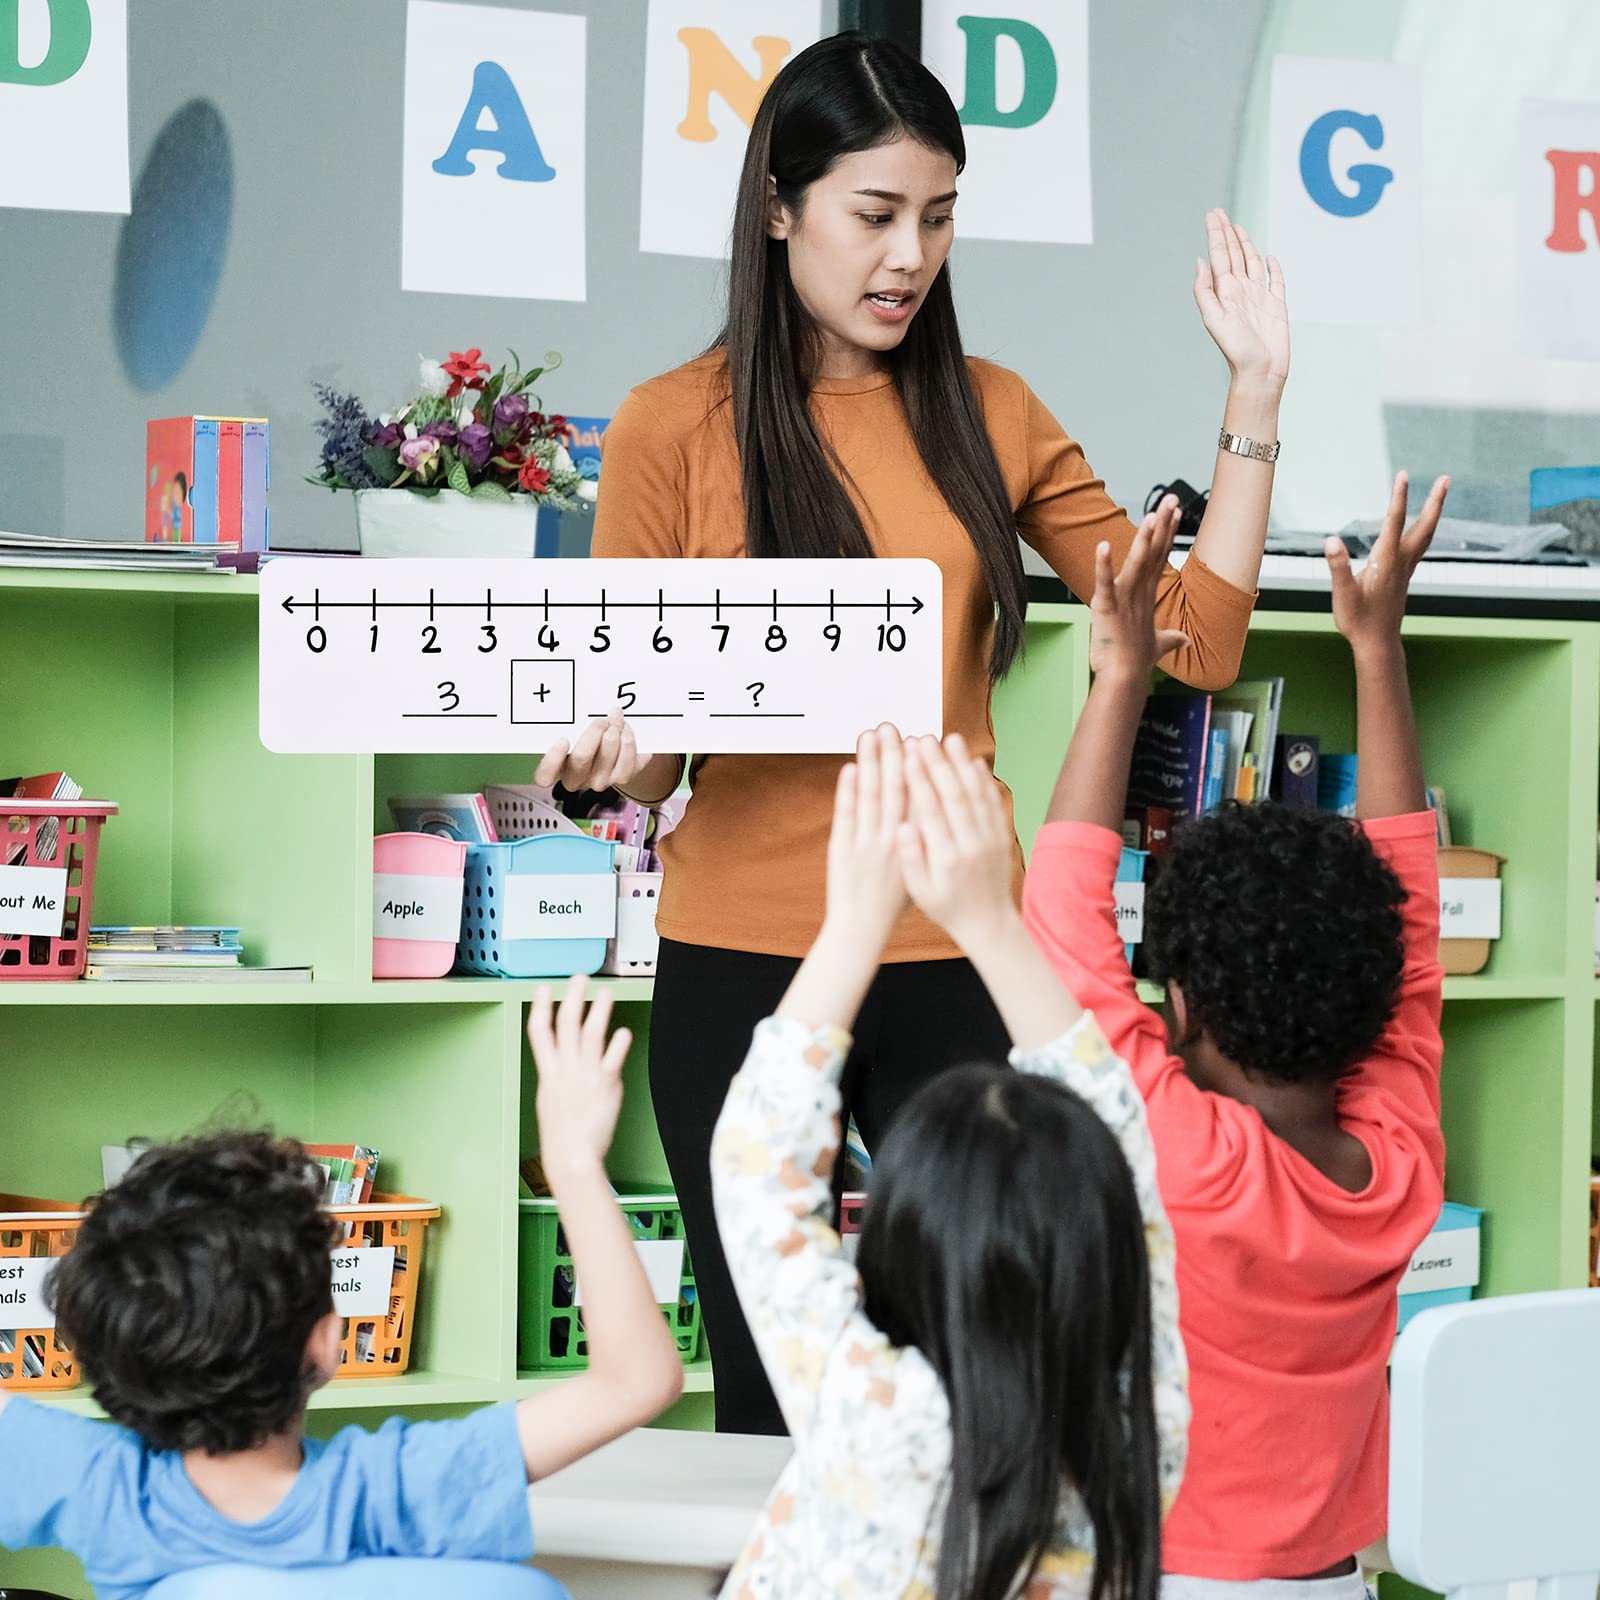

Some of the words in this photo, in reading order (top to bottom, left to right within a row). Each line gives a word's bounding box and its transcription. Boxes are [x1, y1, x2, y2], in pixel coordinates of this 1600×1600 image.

[677, 27, 791, 142] N
[957, 15, 1058, 129] D
[432, 60, 557, 183] A
[1299, 109, 1394, 218] G
[307, 625, 327, 653] 0
[370, 625, 378, 653] 1
[421, 625, 442, 653] 2
[478, 625, 498, 653] 3
[537, 625, 559, 653] 4
[590, 625, 611, 653] 5
[652, 625, 672, 653] 6
[710, 625, 730, 653] 7
[765, 625, 787, 653] 8
[823, 625, 842, 653] 9
[878, 625, 906, 653] 10
[437, 681, 460, 712] 3
[533, 683, 551, 703] +
[617, 681, 636, 710] 5
[688, 691, 705, 701] =
[746, 682, 765, 708] ?
[32, 895, 56, 910] Me
[382, 900, 424, 920] Apple
[539, 900, 582, 914] Beach
[1411, 1258, 1453, 1272] Leaves
